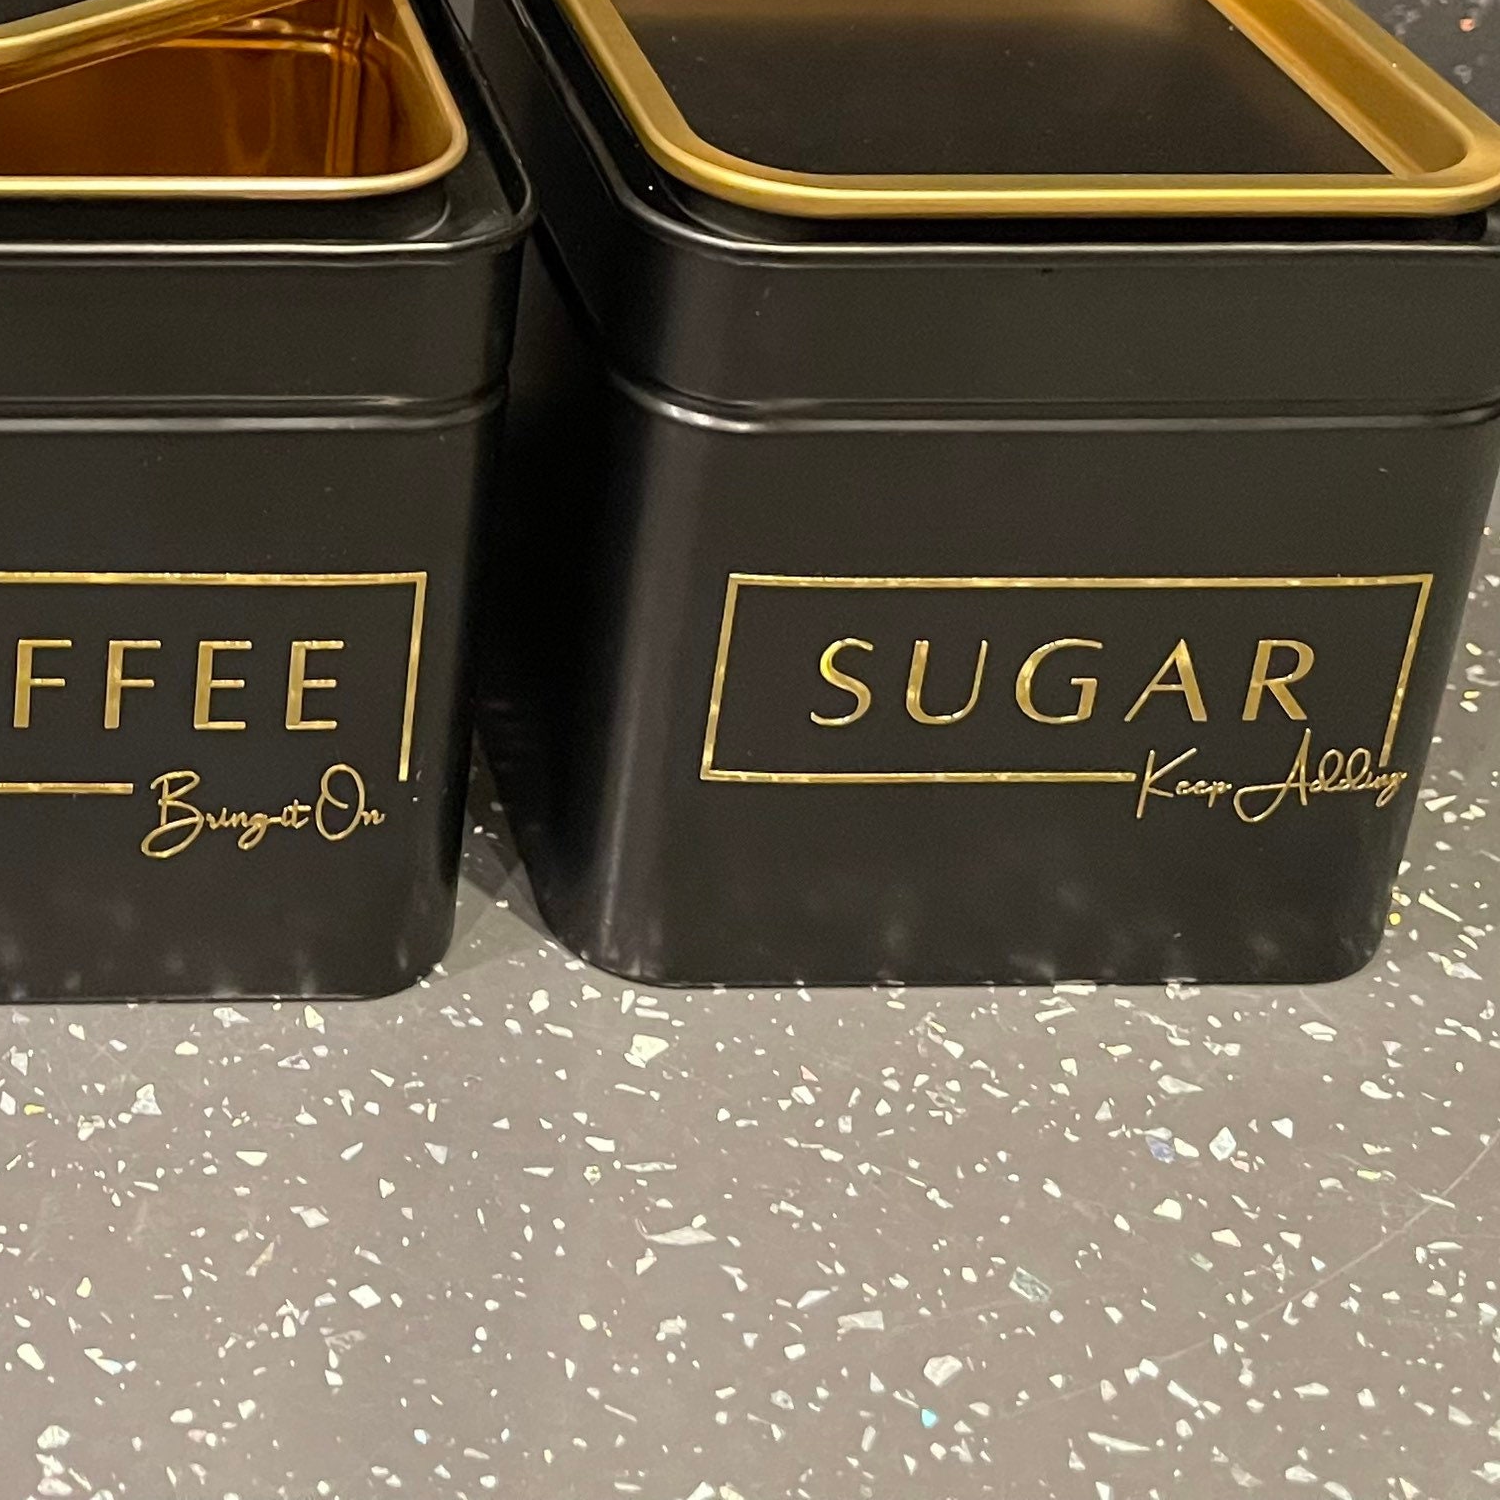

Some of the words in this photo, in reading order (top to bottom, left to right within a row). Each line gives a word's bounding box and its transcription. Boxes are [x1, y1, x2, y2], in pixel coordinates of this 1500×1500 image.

[808, 636, 1317, 727] SUGAR
[141, 769, 269, 859] Bring
[280, 798, 312, 830] it
[315, 762, 385, 841] On
[1135, 747, 1232, 819] Keep
[1233, 727, 1408, 823] Adding
